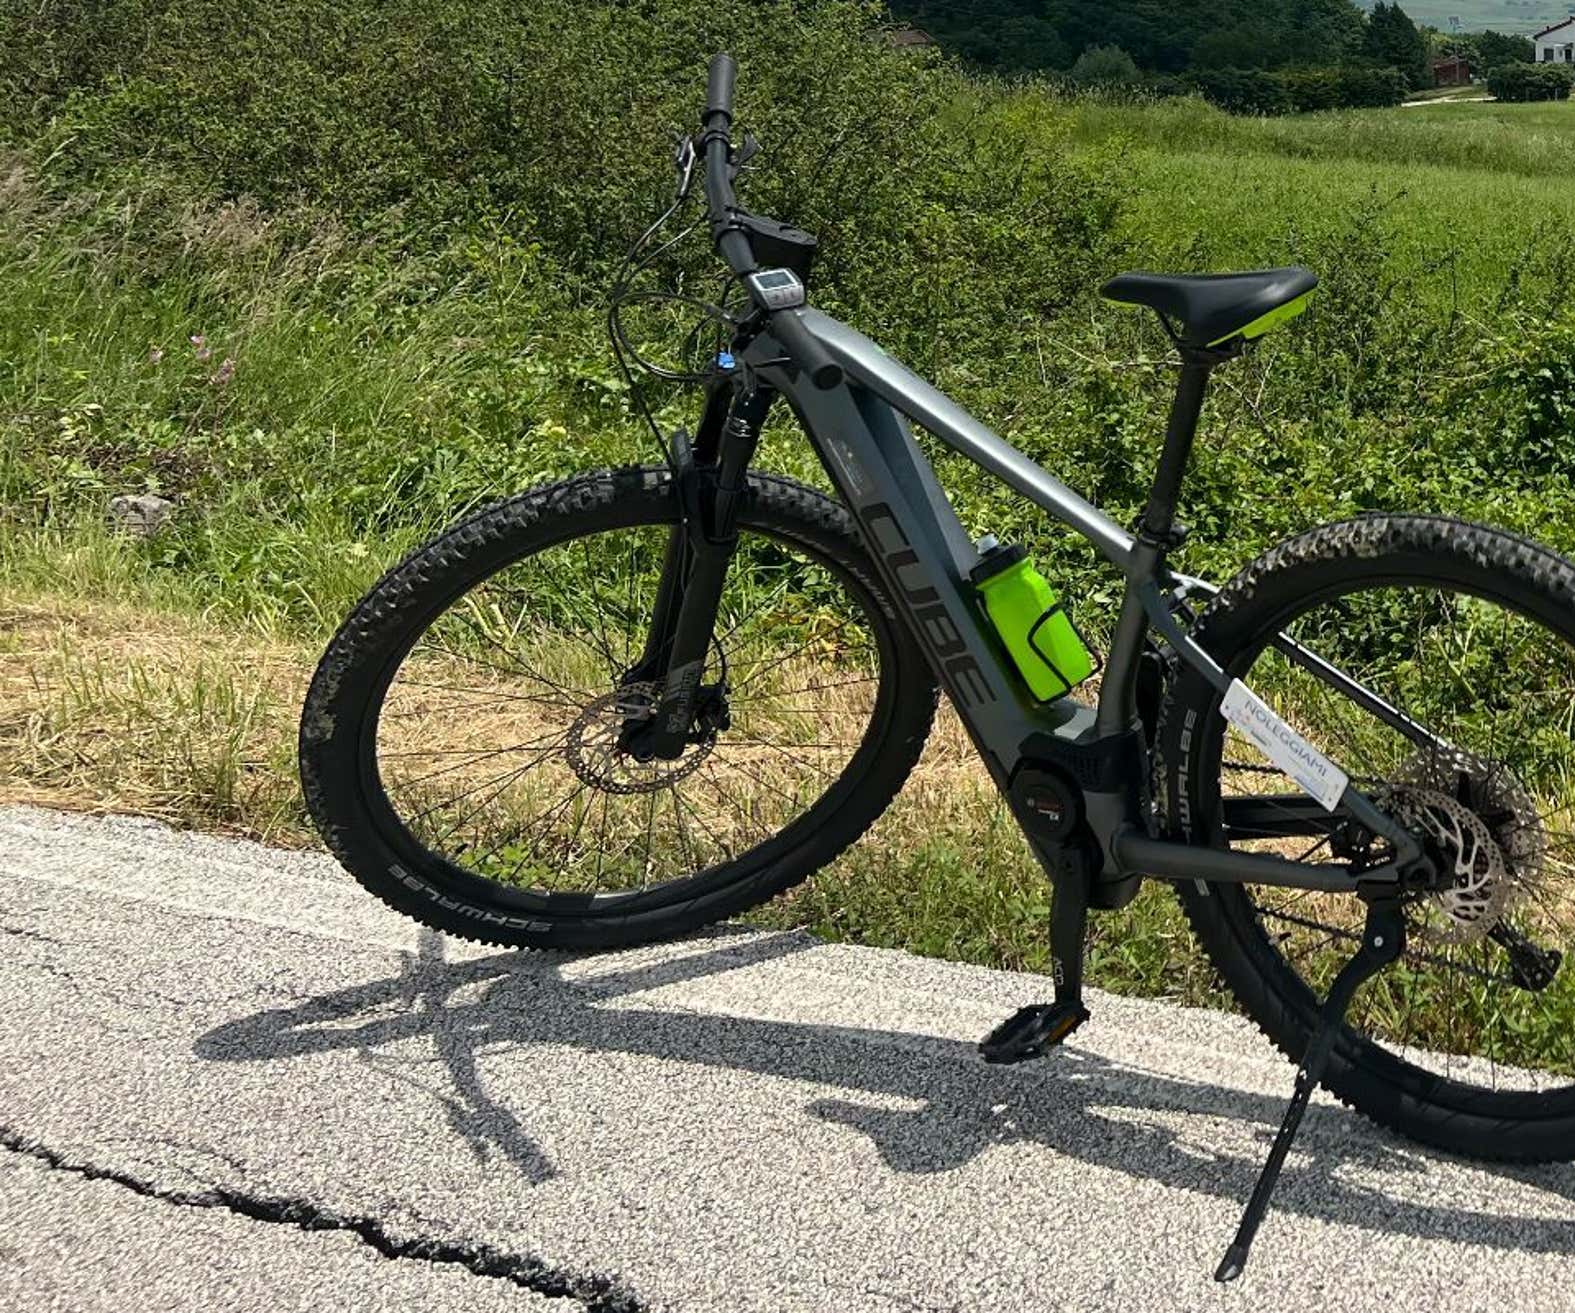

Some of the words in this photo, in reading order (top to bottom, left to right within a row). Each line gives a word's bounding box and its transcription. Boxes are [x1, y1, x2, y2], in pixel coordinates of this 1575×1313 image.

[860, 502, 997, 707] CUBE
[1245, 700, 1328, 777] NOLEGGIAMI
[387, 863, 552, 933] SCHWALBE
